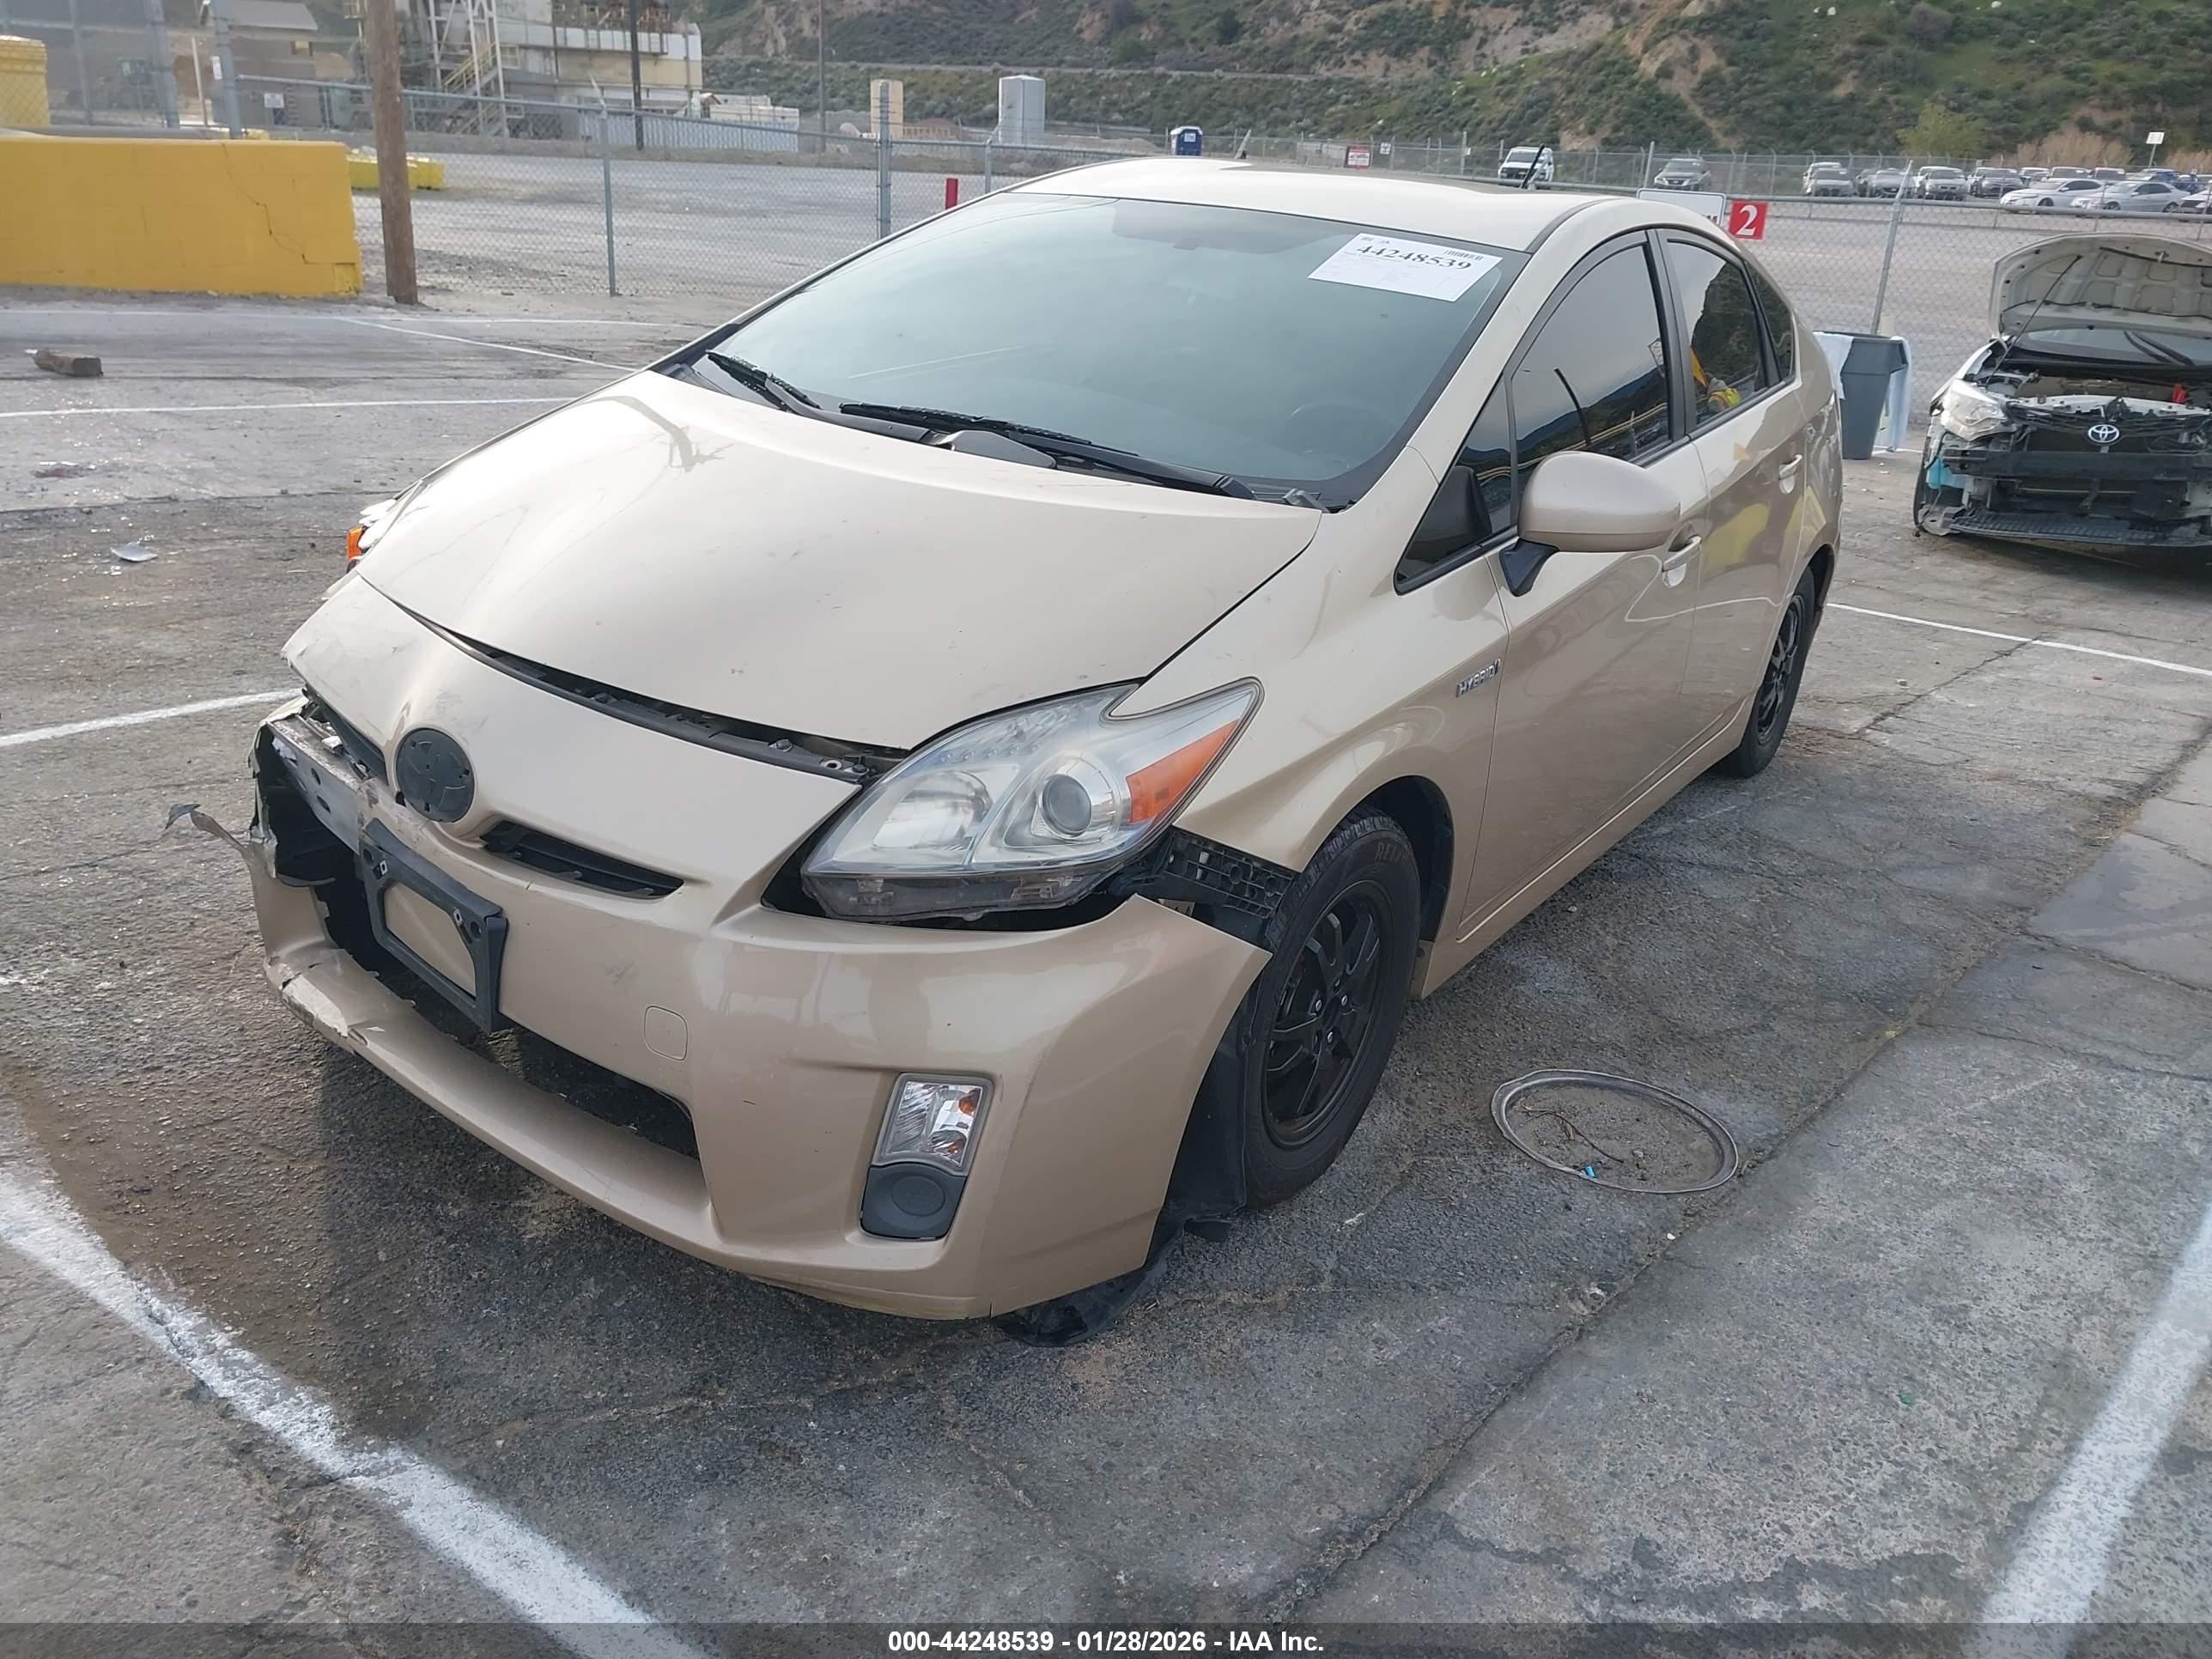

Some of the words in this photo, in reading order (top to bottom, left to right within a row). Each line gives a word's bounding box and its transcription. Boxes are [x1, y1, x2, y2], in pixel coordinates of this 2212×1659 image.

[1735, 204, 1759, 236] 2
[1356, 245, 1473, 270] 44248539
[1455, 657, 1502, 698] HYBRID
